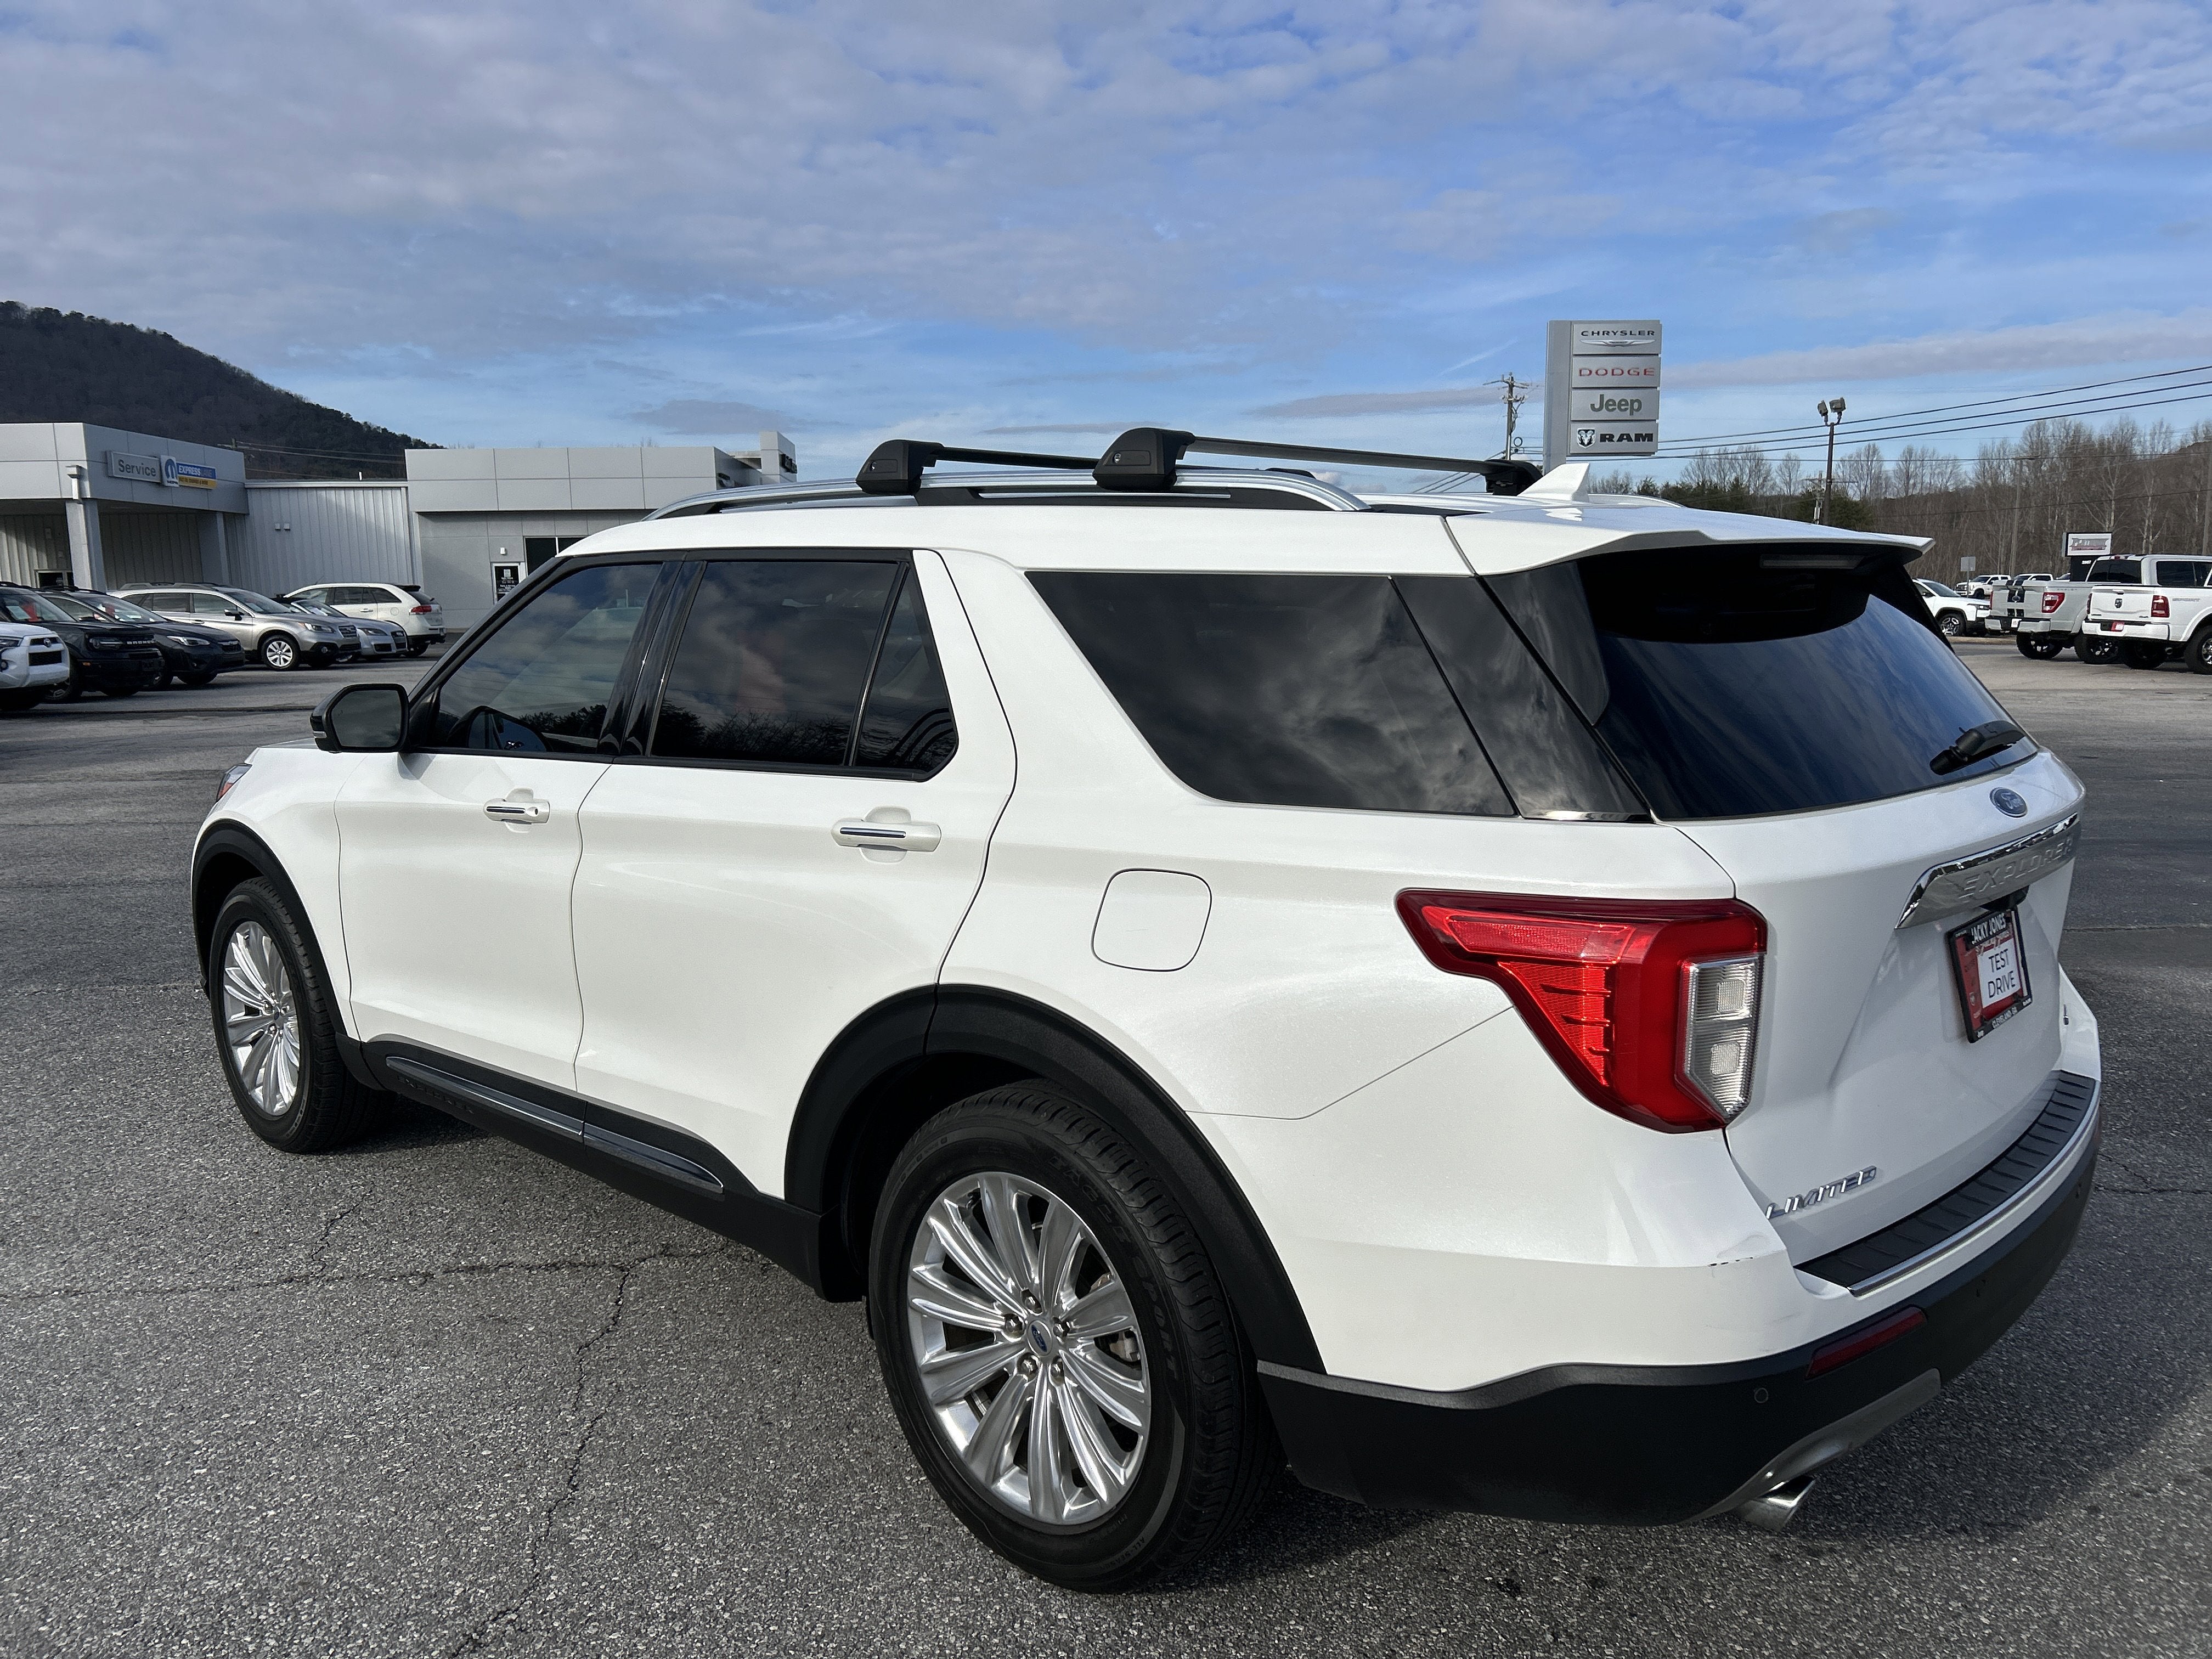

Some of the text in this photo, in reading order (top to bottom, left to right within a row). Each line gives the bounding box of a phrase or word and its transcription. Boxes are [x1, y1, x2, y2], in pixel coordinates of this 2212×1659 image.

[1579, 368, 1655, 377] DODGE
[1590, 394, 1642, 416] Jeep
[1600, 433, 1654, 443] RAM
[118, 459, 156, 477] Service
[178, 465, 201, 476] EXPRESS
[2001, 793, 2024, 809] Ford
[1957, 838, 2073, 899] EXPLORER
[1989, 913, 2006, 935] JONES
[1988, 948, 2008, 973] TEST
[1988, 970, 2016, 998] DRIVE
[1766, 1165, 1877, 1219] LIMITED
